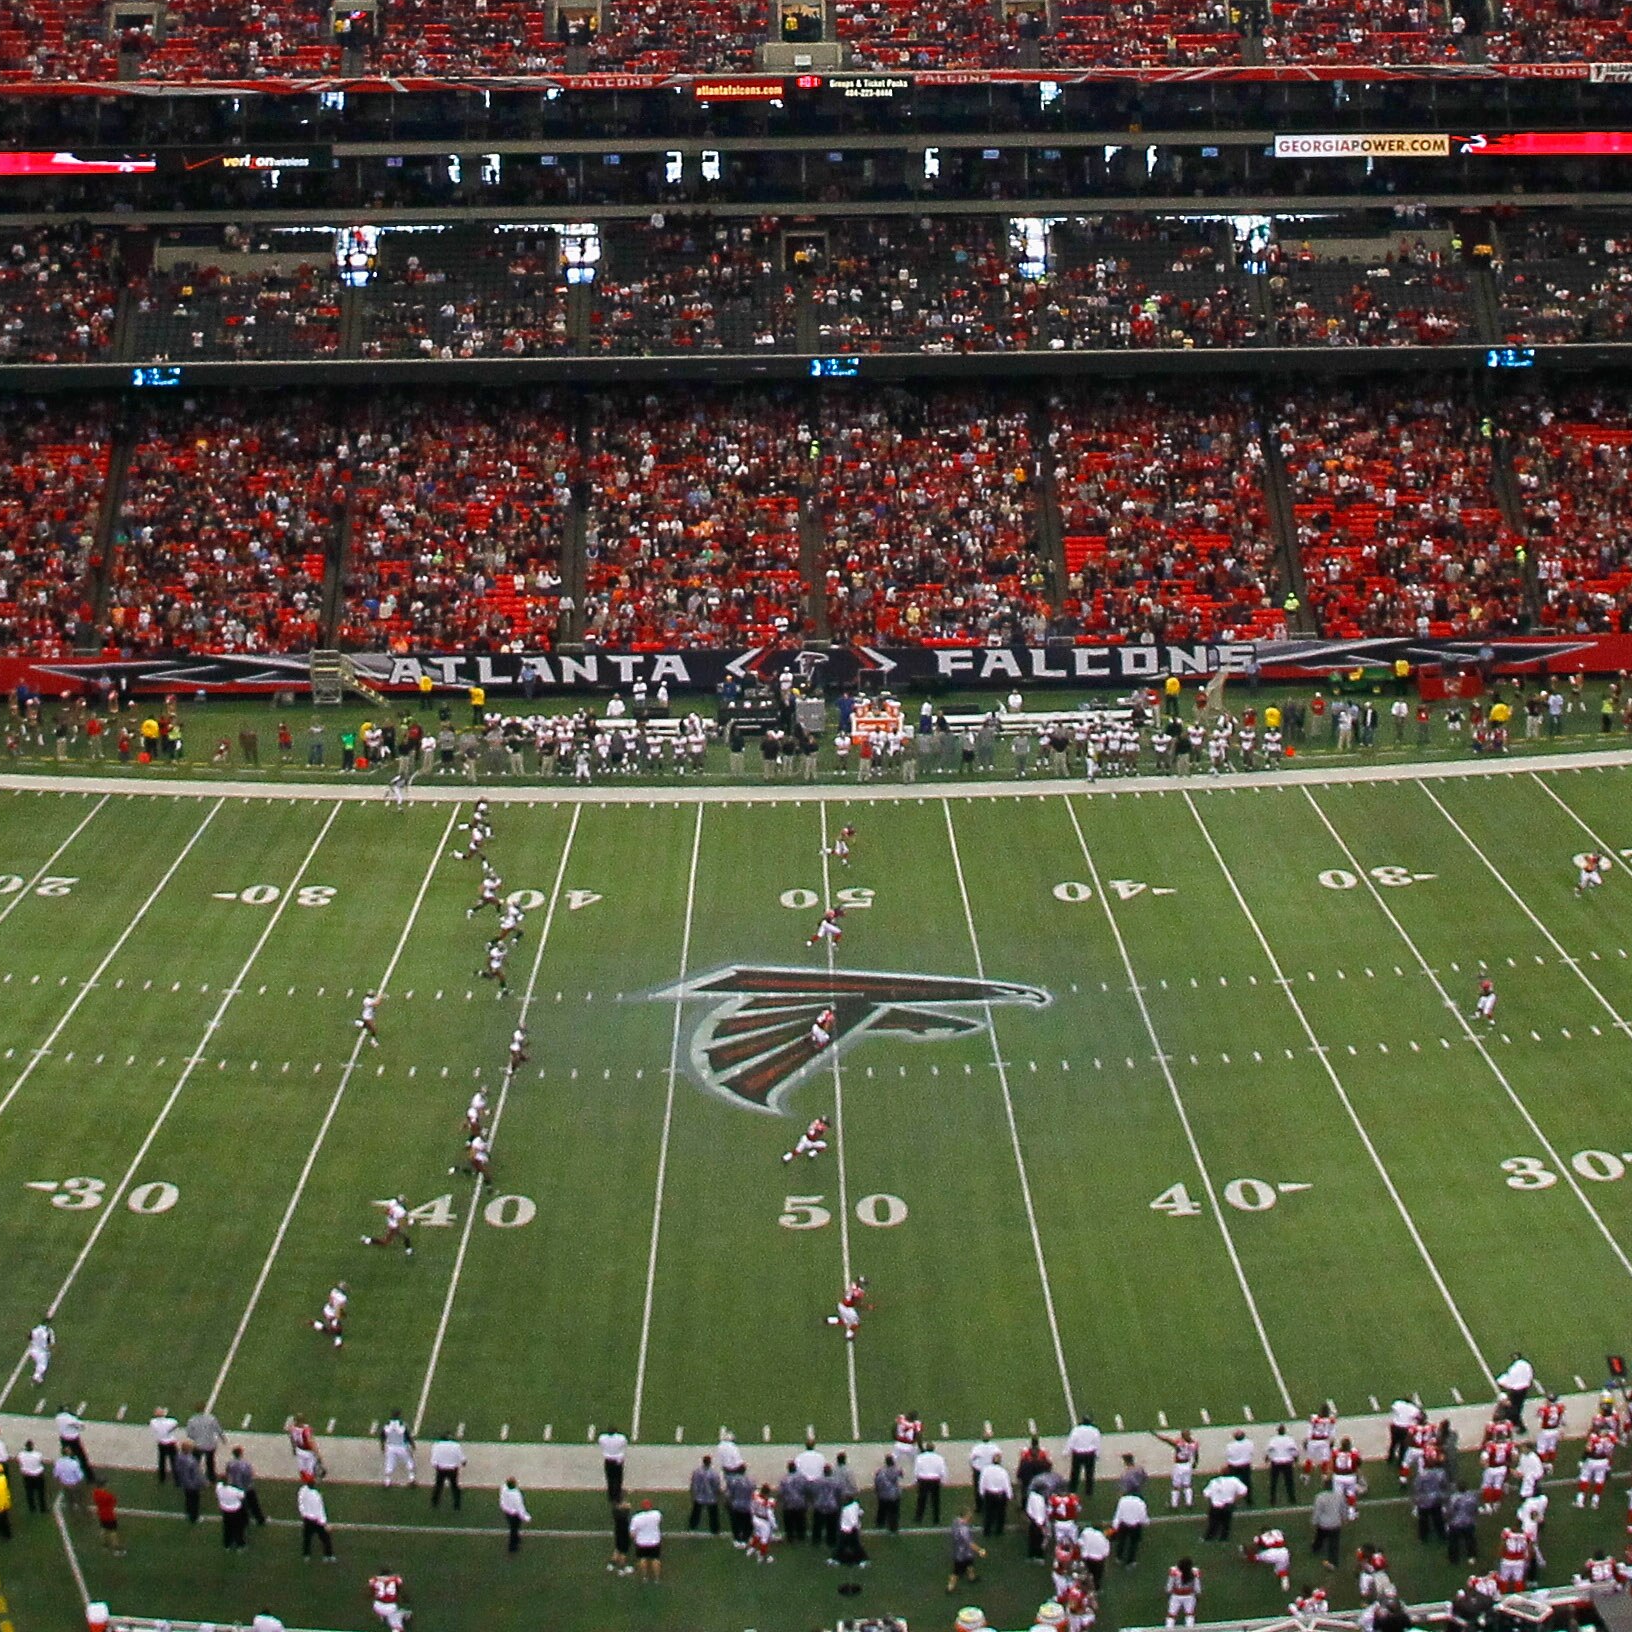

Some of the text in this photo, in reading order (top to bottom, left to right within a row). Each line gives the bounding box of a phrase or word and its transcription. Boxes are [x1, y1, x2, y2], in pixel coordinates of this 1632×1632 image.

[570, 77, 653, 87] FALCONS
[915, 74, 992, 83] FALCONS
[1509, 66, 1588, 76] FALCONS
[697, 85, 782, 95] atlantafalcons.com
[1278, 139, 1446, 154] GEORGIAPOWER.COM
[223, 154, 275, 168] verizon
[388, 644, 1256, 683] ATLANTA FALCONS
[1052, 878, 1149, 903] 40
[1318, 865, 1413, 891] 30
[239, 883, 337, 908] 30
[507, 889, 603, 911] 40
[780, 887, 876, 911] 50
[1499, 1149, 1626, 1191] 30
[49, 1176, 180, 1215] 30
[1149, 1177, 1277, 1217] 40
[405, 1193, 537, 1228] 40
[777, 1193, 909, 1229] 50
